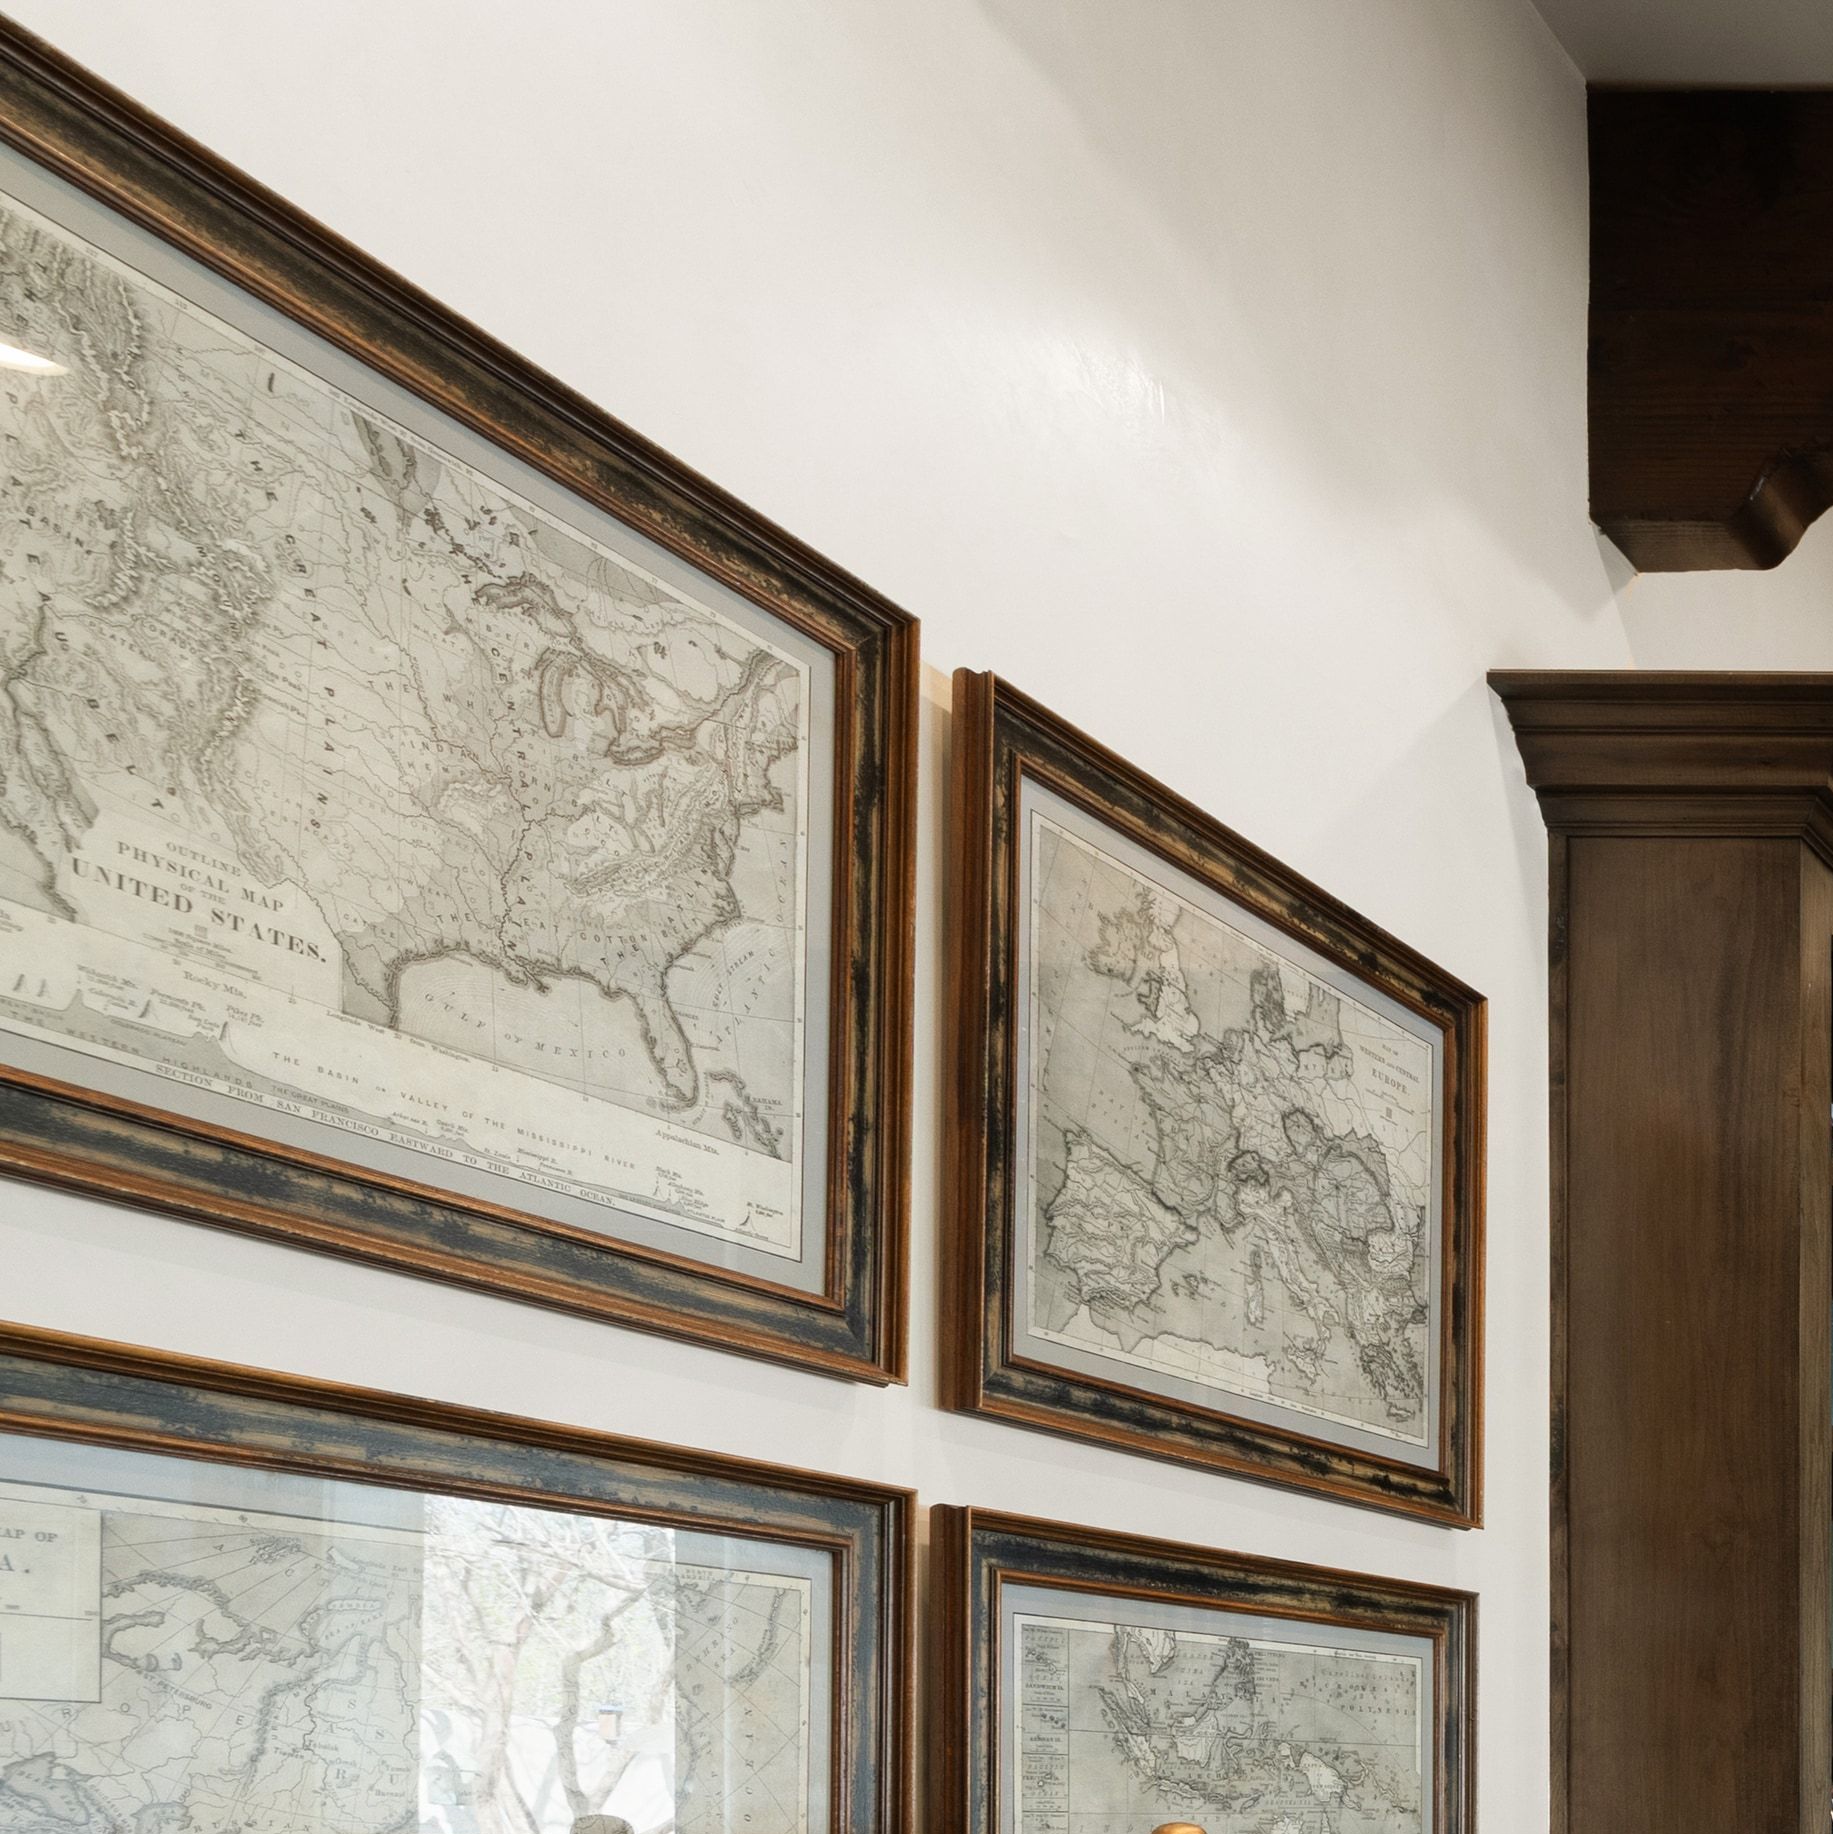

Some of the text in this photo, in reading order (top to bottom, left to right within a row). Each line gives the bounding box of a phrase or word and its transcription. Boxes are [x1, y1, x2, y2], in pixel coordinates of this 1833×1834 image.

[118, 842, 284, 912] PHYSICAL MAP
[166, 841, 241, 877] OUTLINE
[73, 857, 327, 964] UNITED STATES.
[179, 883, 226, 905] OF THE
[182, 971, 217, 991] Rocky
[424, 992, 627, 1060] GULF OF MEXICO
[156, 1063, 617, 1207] SECTION FROM SAN FRANCISCO EASTWARD TO THE ATLANTIC OCEAN.
[273, 1051, 300, 1067] THE
[317, 1066, 360, 1085] BASIN
[401, 1091, 449, 1112] VALLEY
[463, 1111, 475, 1122] OF
[485, 1117, 506, 1131] THE
[517, 1127, 593, 1157] MISSISSIPPI
[604, 1154, 636, 1170] RIVER
[656, 1129, 703, 1151] Appalachian
[34, 1532, 59, 1544] OF
